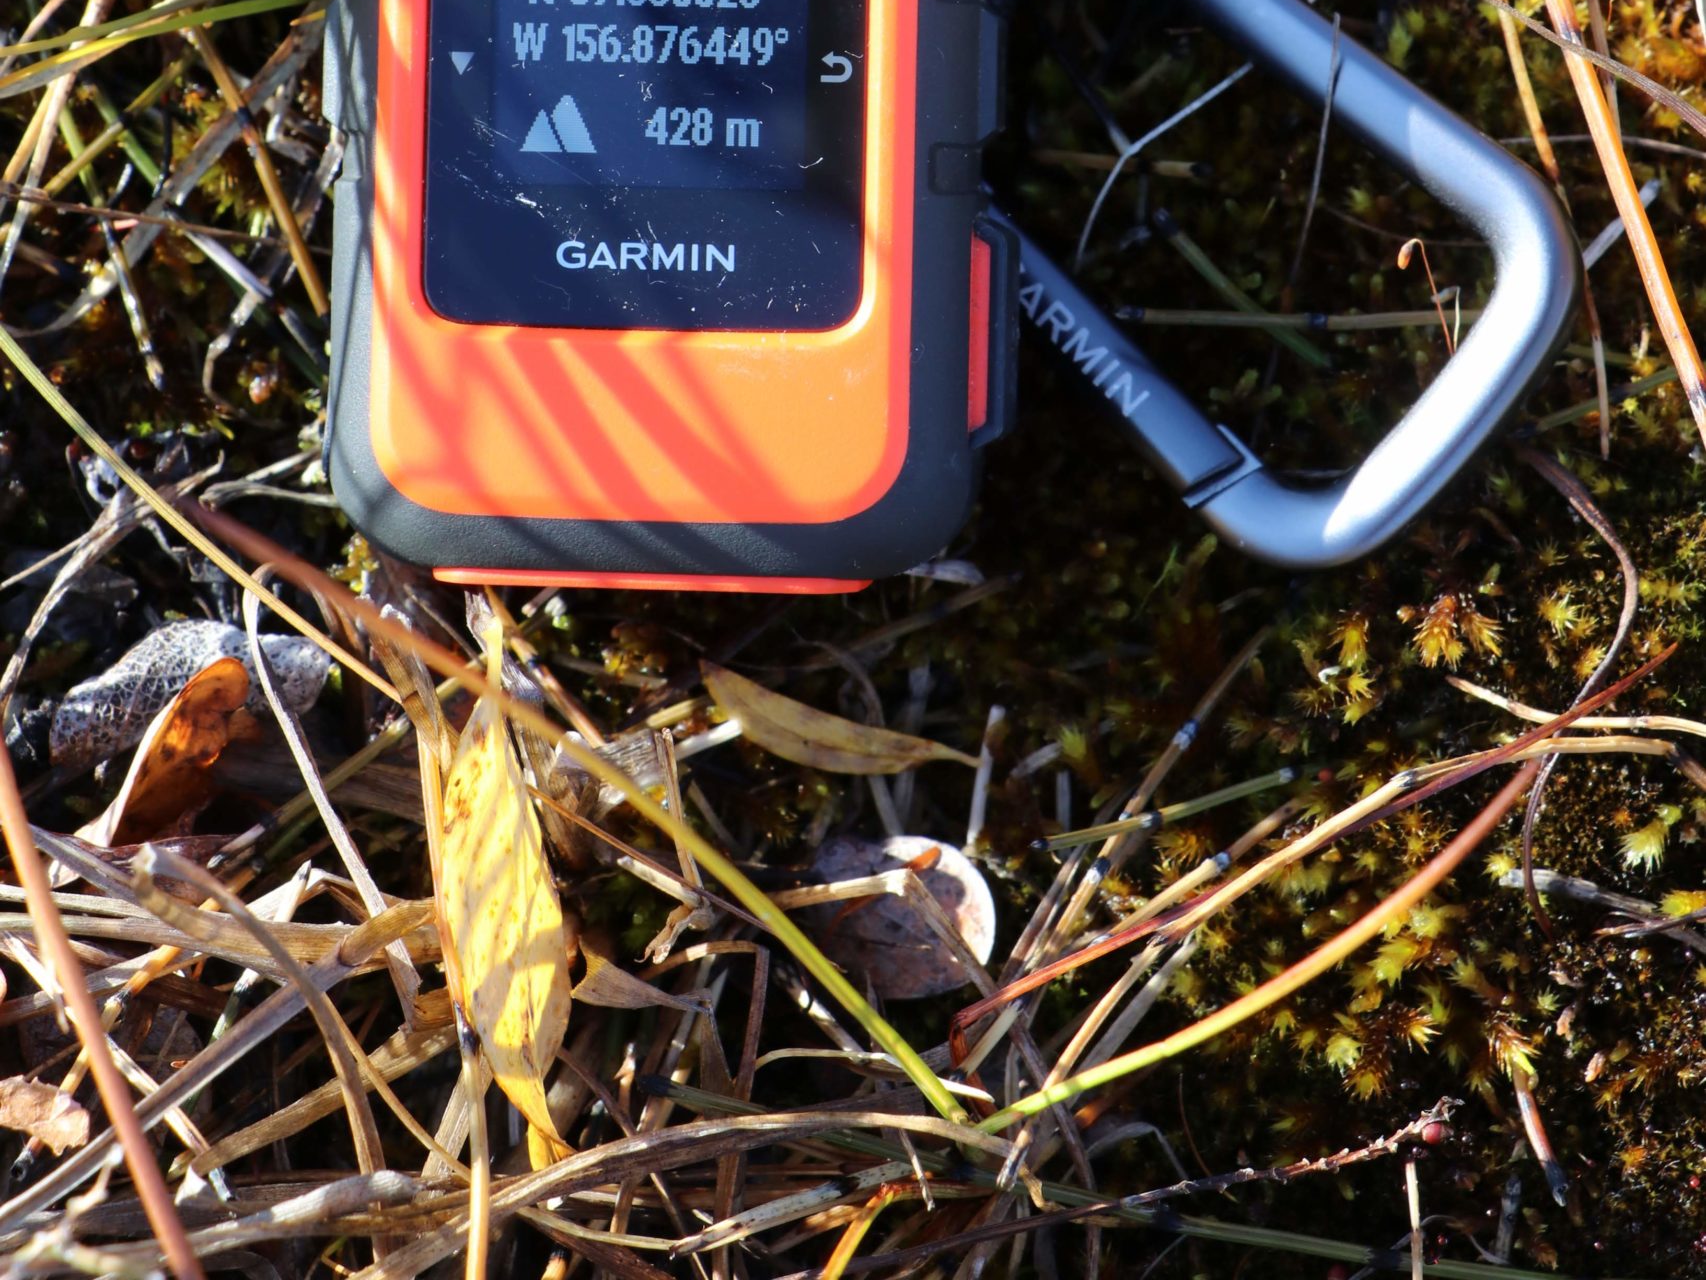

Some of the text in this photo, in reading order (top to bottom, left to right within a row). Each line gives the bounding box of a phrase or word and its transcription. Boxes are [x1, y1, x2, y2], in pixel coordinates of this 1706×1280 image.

[512, 22, 789, 66] W 156.876449°
[644, 106, 762, 148] 428 m
[556, 241, 736, 272] GARMIN
[1018, 262, 1150, 418] ARMIN
